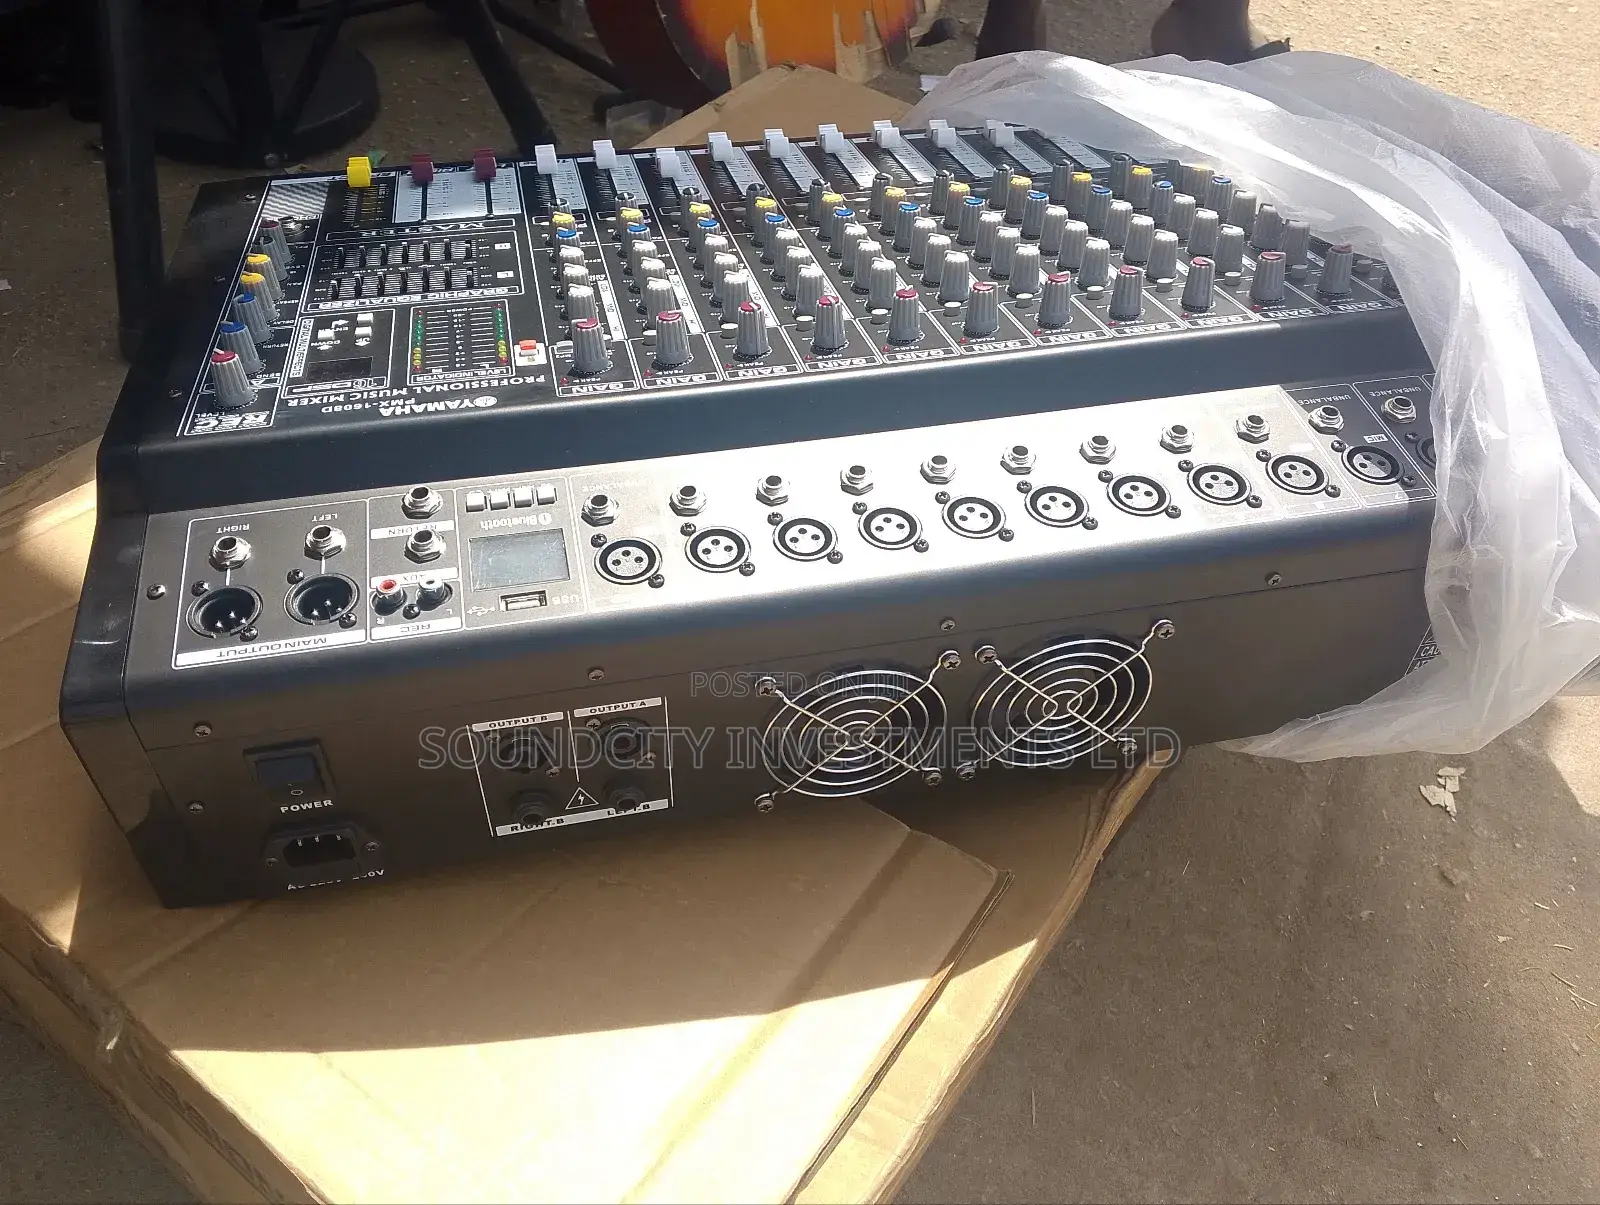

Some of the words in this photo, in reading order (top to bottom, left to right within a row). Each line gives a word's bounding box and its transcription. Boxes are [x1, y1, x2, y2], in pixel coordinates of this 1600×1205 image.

[428, 287, 508, 299] GRAPHIC
[319, 294, 421, 309] EQUALIZER
[1270, 309, 1314, 318] GAIN
[1197, 316, 1243, 327] GAIN
[1124, 323, 1170, 335] GAIN
[1050, 332, 1096, 345] GAIN
[972, 341, 1021, 354] GAIN
[896, 350, 944, 361] GAIN
[817, 358, 867, 369] GAIN
[416, 371, 474, 382] INDICATOR
[738, 367, 787, 378] GAIN
[413, 374, 545, 394] PROFESSIONAL
[655, 374, 706, 386] GAIN
[349, 388, 408, 401] MUSIC
[572, 383, 623, 395] GAIN
[1369, 386, 1422, 397] UNBALANCE
[287, 394, 345, 407] MIXER
[321, 398, 415, 413] PMX-1608D
[1298, 394, 1352, 406] UNBALANCE
[378, 399, 475, 417] YAMAHA
[192, 411, 270, 433] REC
[312, 513, 338, 522] LEFT
[480, 514, 538, 530] Bluetooth
[216, 524, 250, 534] RIGHT
[552, 594, 580, 605] USB
[376, 617, 385, 625] R
[400, 623, 431, 633] REC
[589, 702, 635, 714] OUTPUT
[488, 716, 537, 729] OUTPUT
[280, 799, 333, 813] POWER
